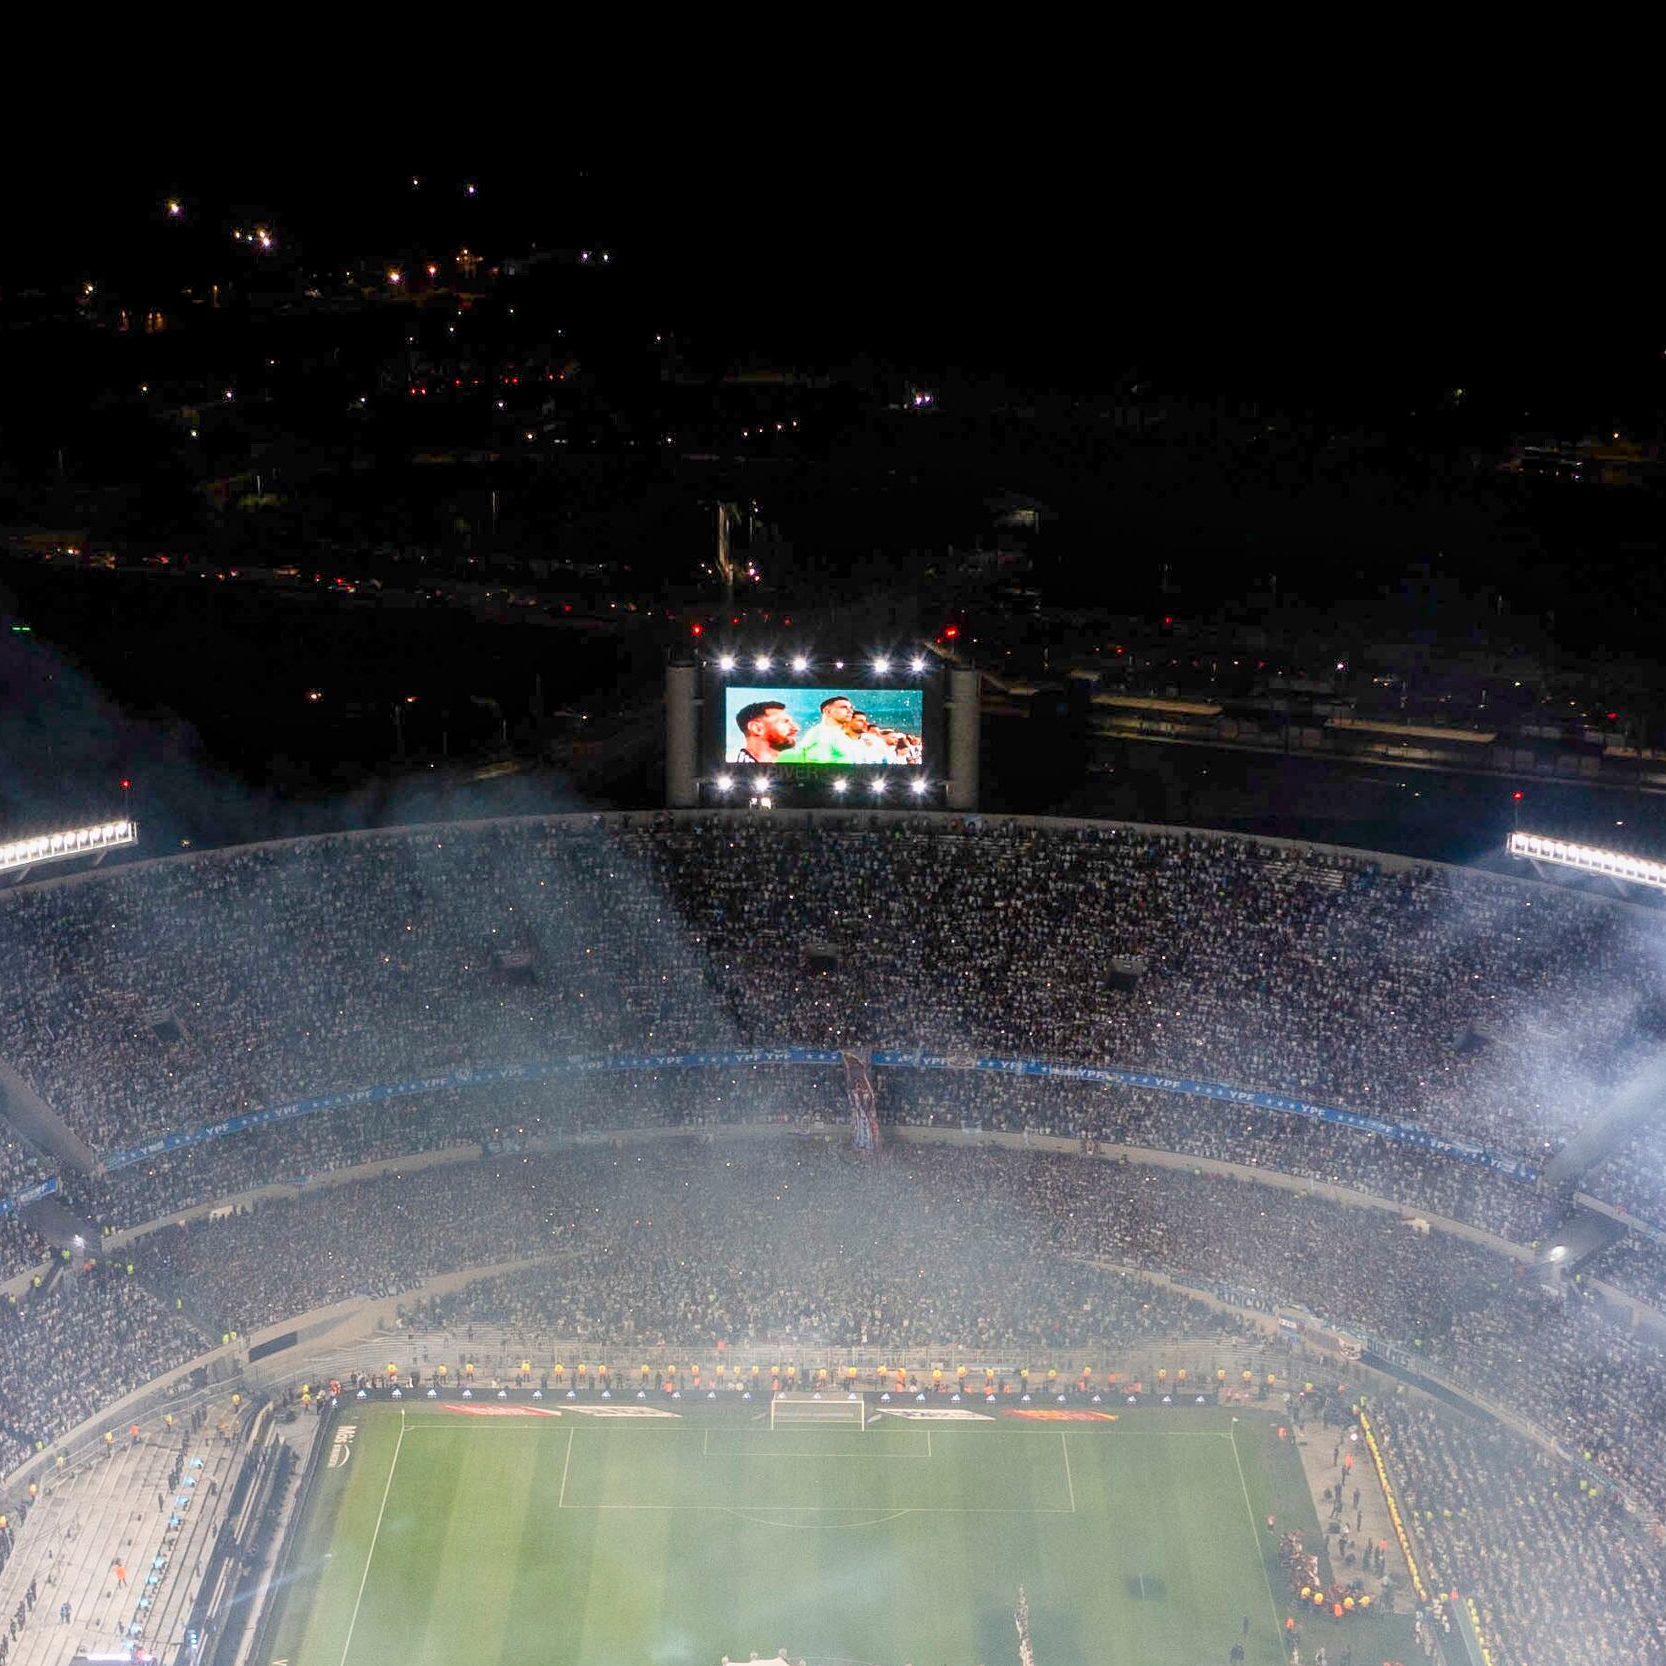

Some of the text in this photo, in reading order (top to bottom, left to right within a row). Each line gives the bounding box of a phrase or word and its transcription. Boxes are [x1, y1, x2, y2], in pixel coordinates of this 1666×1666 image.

[656, 1056, 684, 1065] YPF
[1154, 1078, 1181, 1088] YPF
[346, 1089, 373, 1101] YPF
[1230, 1091, 1255, 1101] YPF
[205, 1122, 231, 1137] YPF
